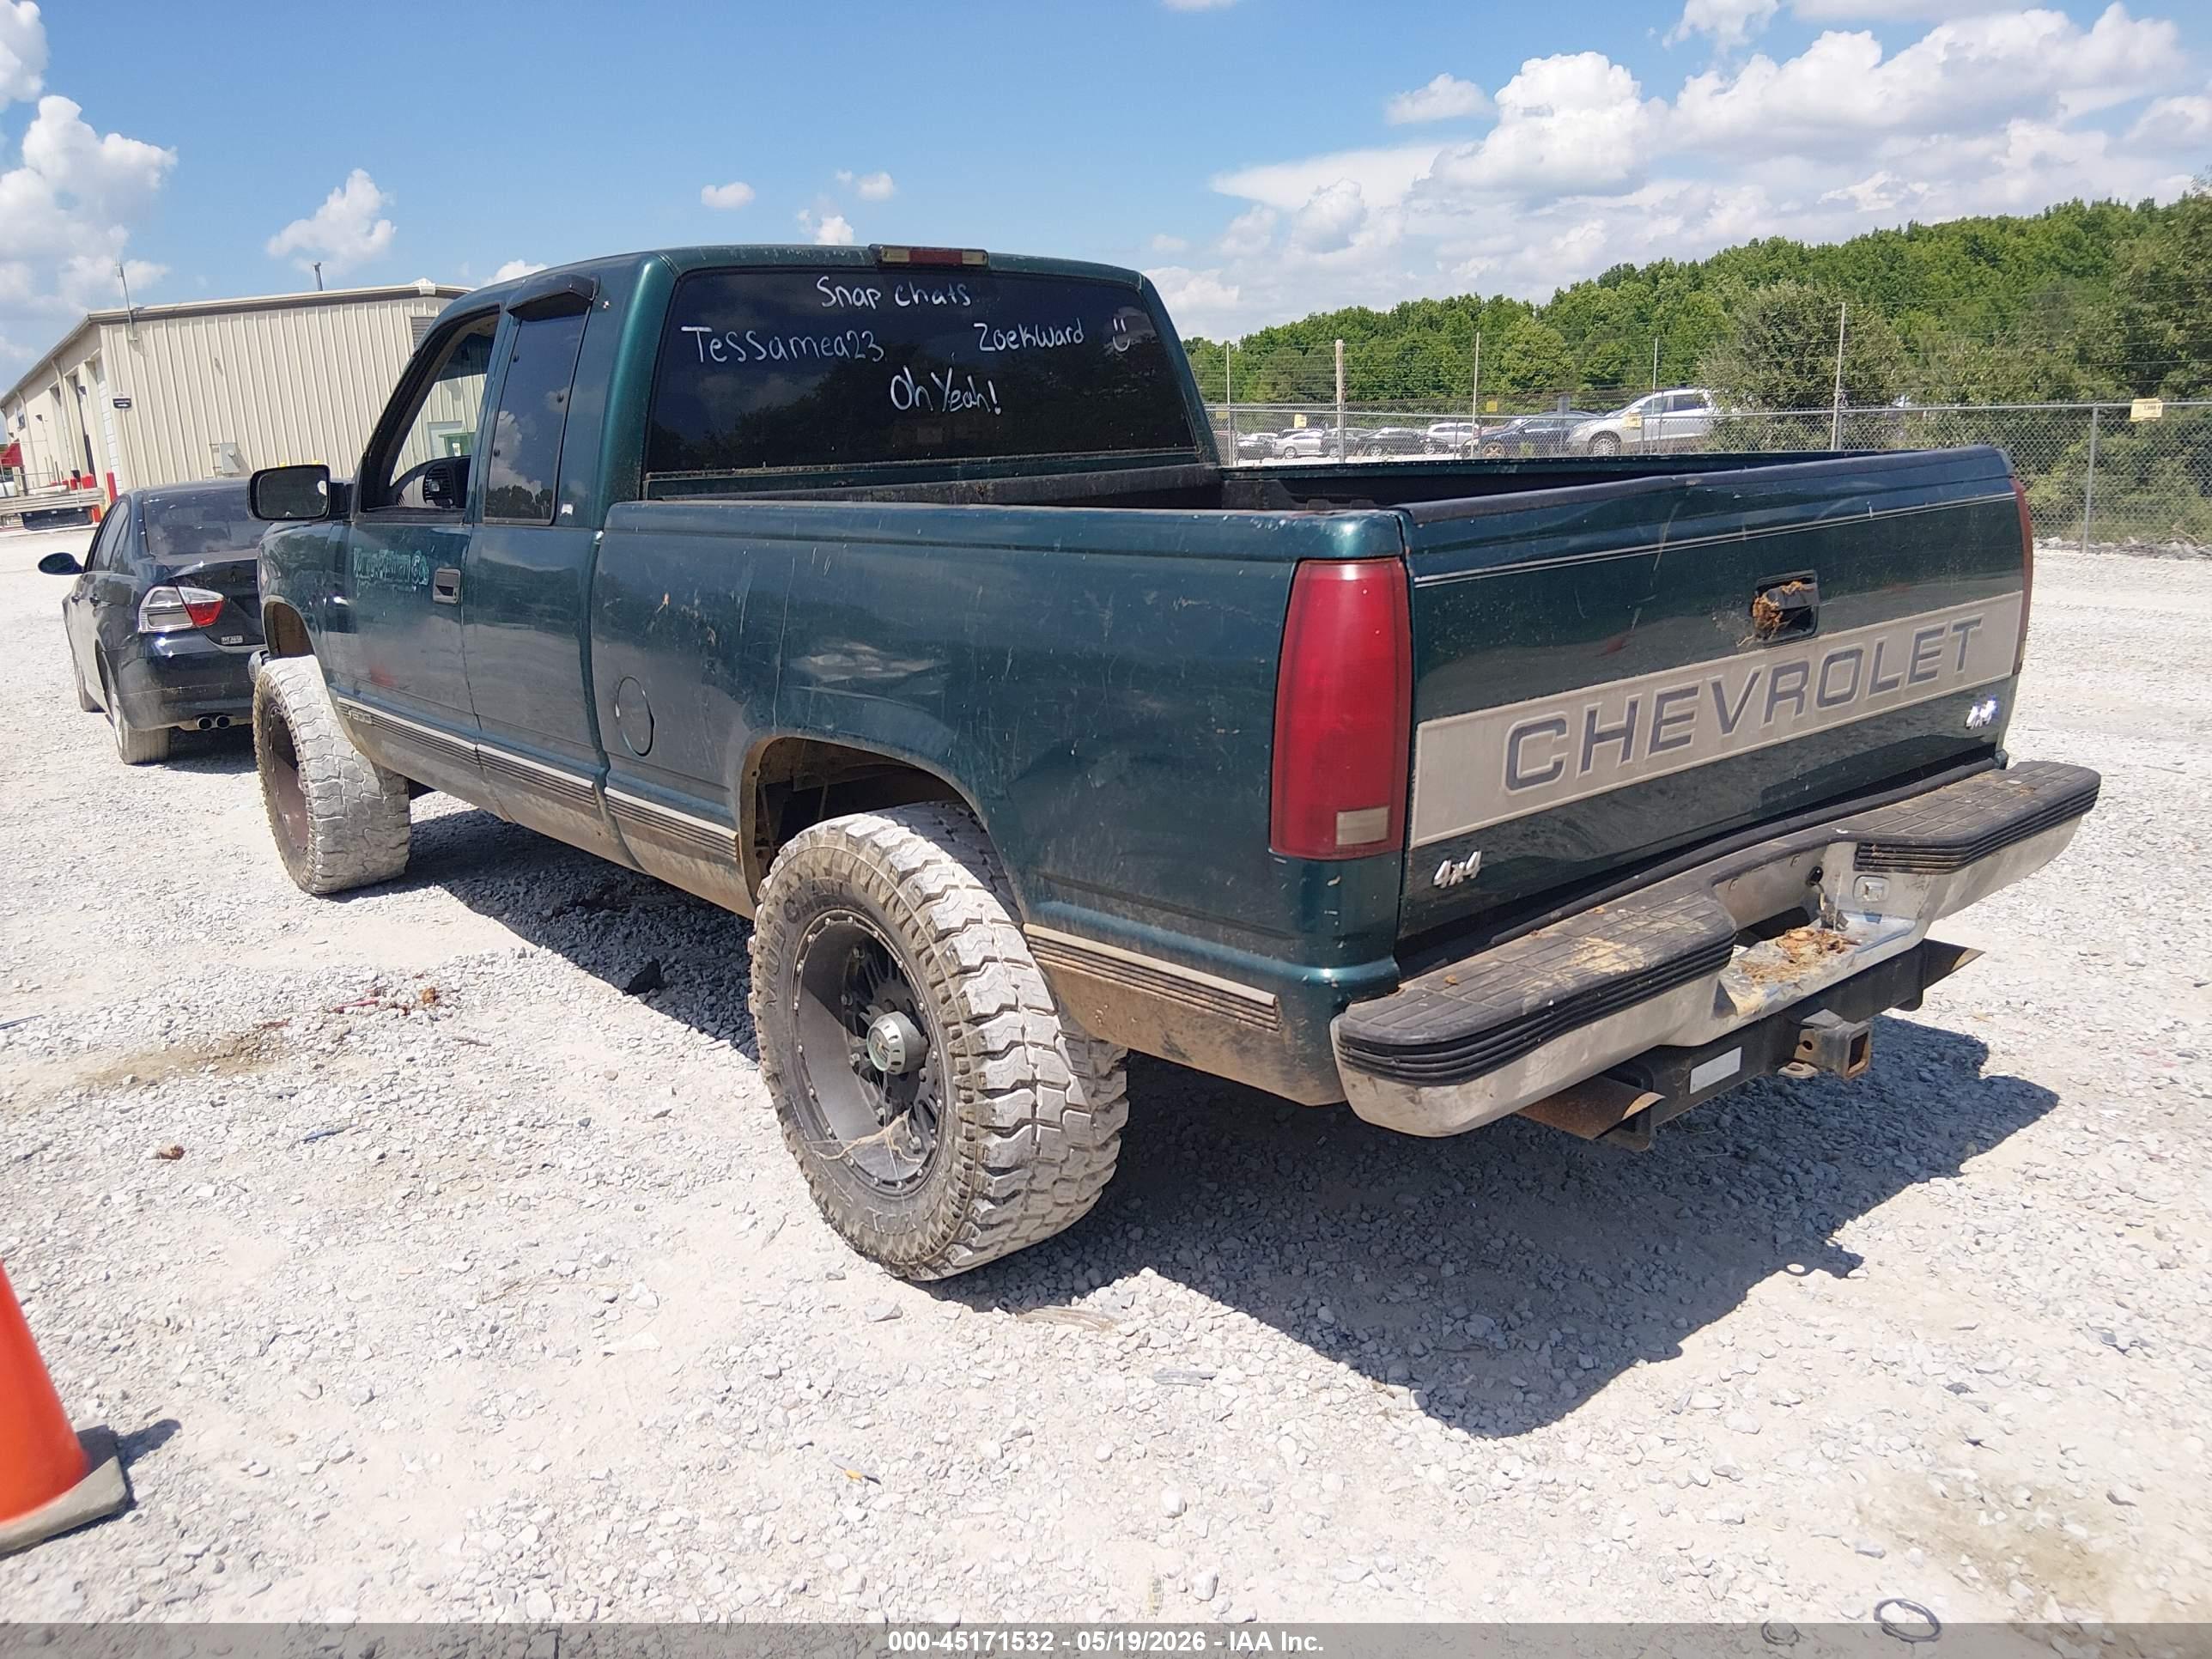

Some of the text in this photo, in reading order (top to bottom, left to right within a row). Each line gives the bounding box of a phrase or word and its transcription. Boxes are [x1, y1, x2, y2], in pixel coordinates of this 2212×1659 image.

[817, 276, 881, 309] Snap
[681, 326, 884, 362] Tessamea23
[890, 365, 1001, 415] Oh Yeah!
[1505, 617, 1983, 795] CHEVROLET
[1432, 851, 1482, 889] 4x4
